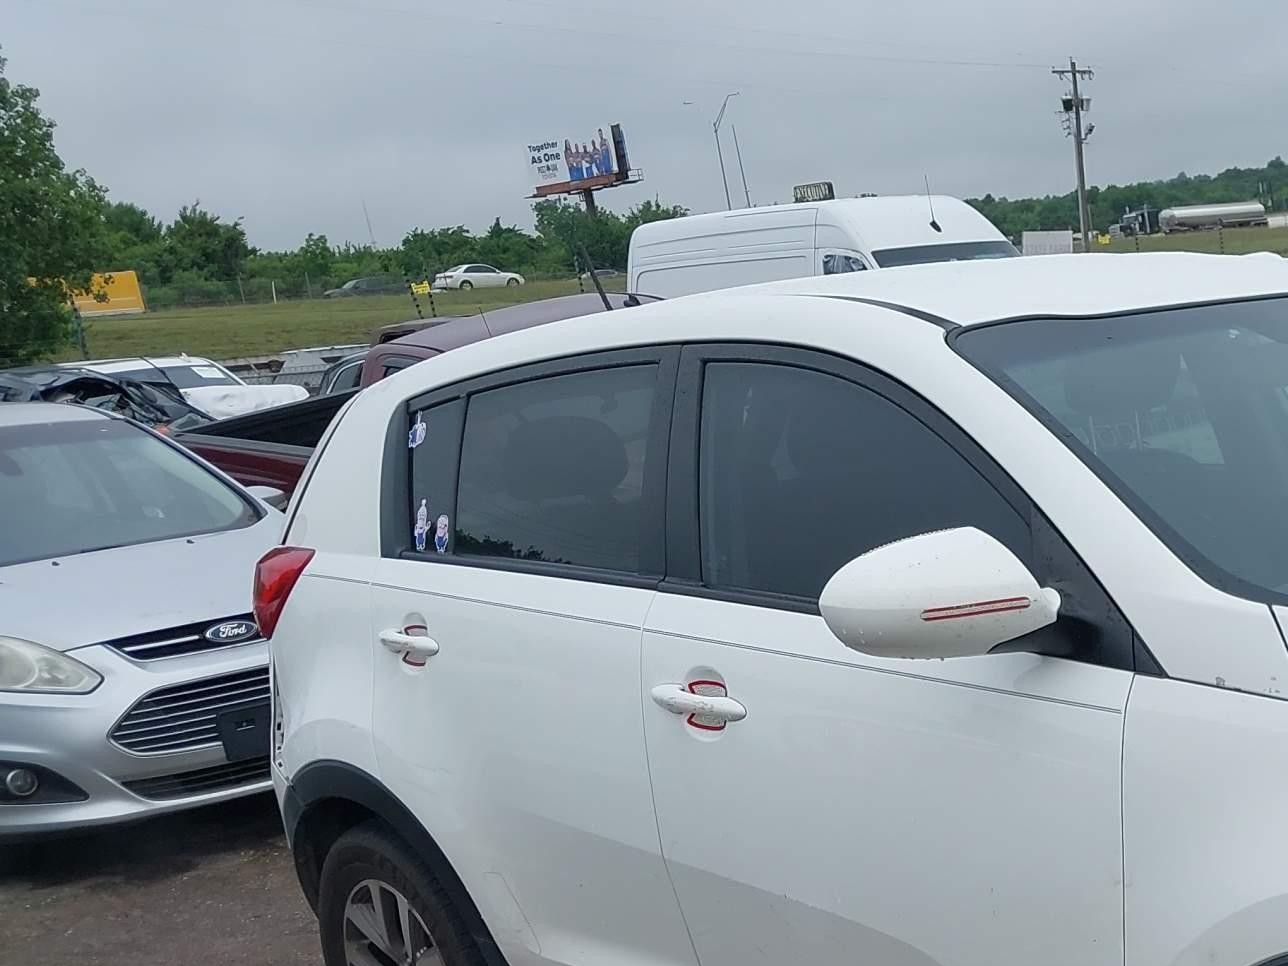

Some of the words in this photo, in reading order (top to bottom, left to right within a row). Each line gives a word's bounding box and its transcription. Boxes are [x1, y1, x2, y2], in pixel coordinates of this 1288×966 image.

[527, 141, 559, 154] Together
[530, 155, 543, 166] As
[543, 151, 561, 162] One
[219, 623, 247, 638] Ford
